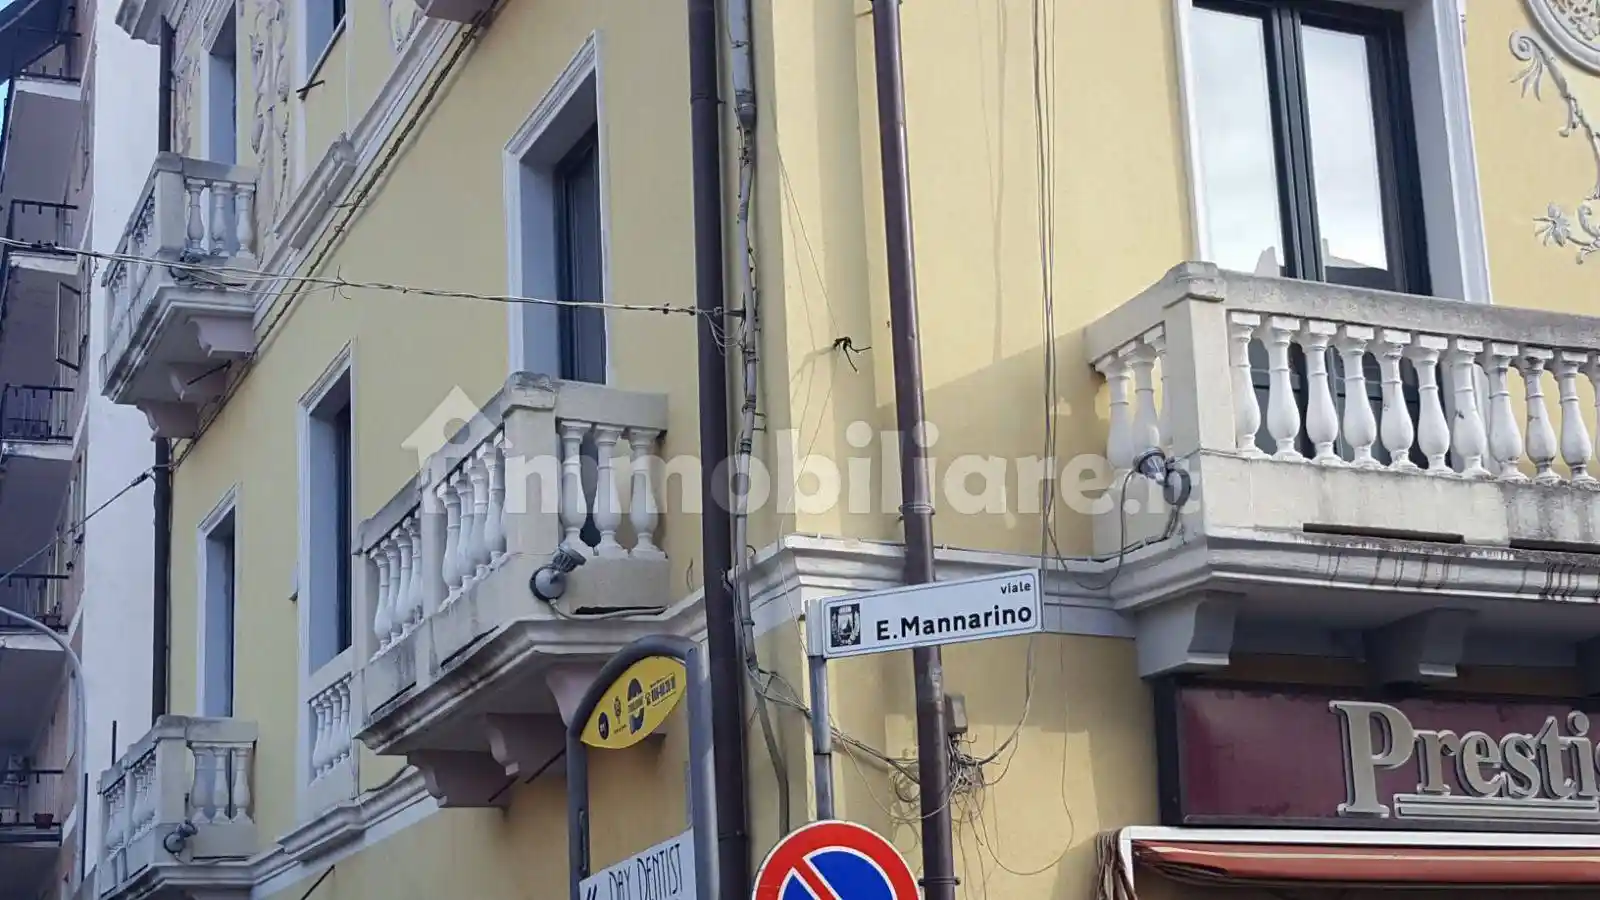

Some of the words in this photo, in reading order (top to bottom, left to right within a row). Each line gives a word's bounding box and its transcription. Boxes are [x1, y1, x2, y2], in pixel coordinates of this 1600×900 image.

[1000, 581, 1032, 595] viale
[876, 604, 1032, 641] E.Mannarino
[1328, 699, 1600, 818] Presti
[608, 865, 631, 900] DAY
[636, 843, 683, 900] DENTIST
